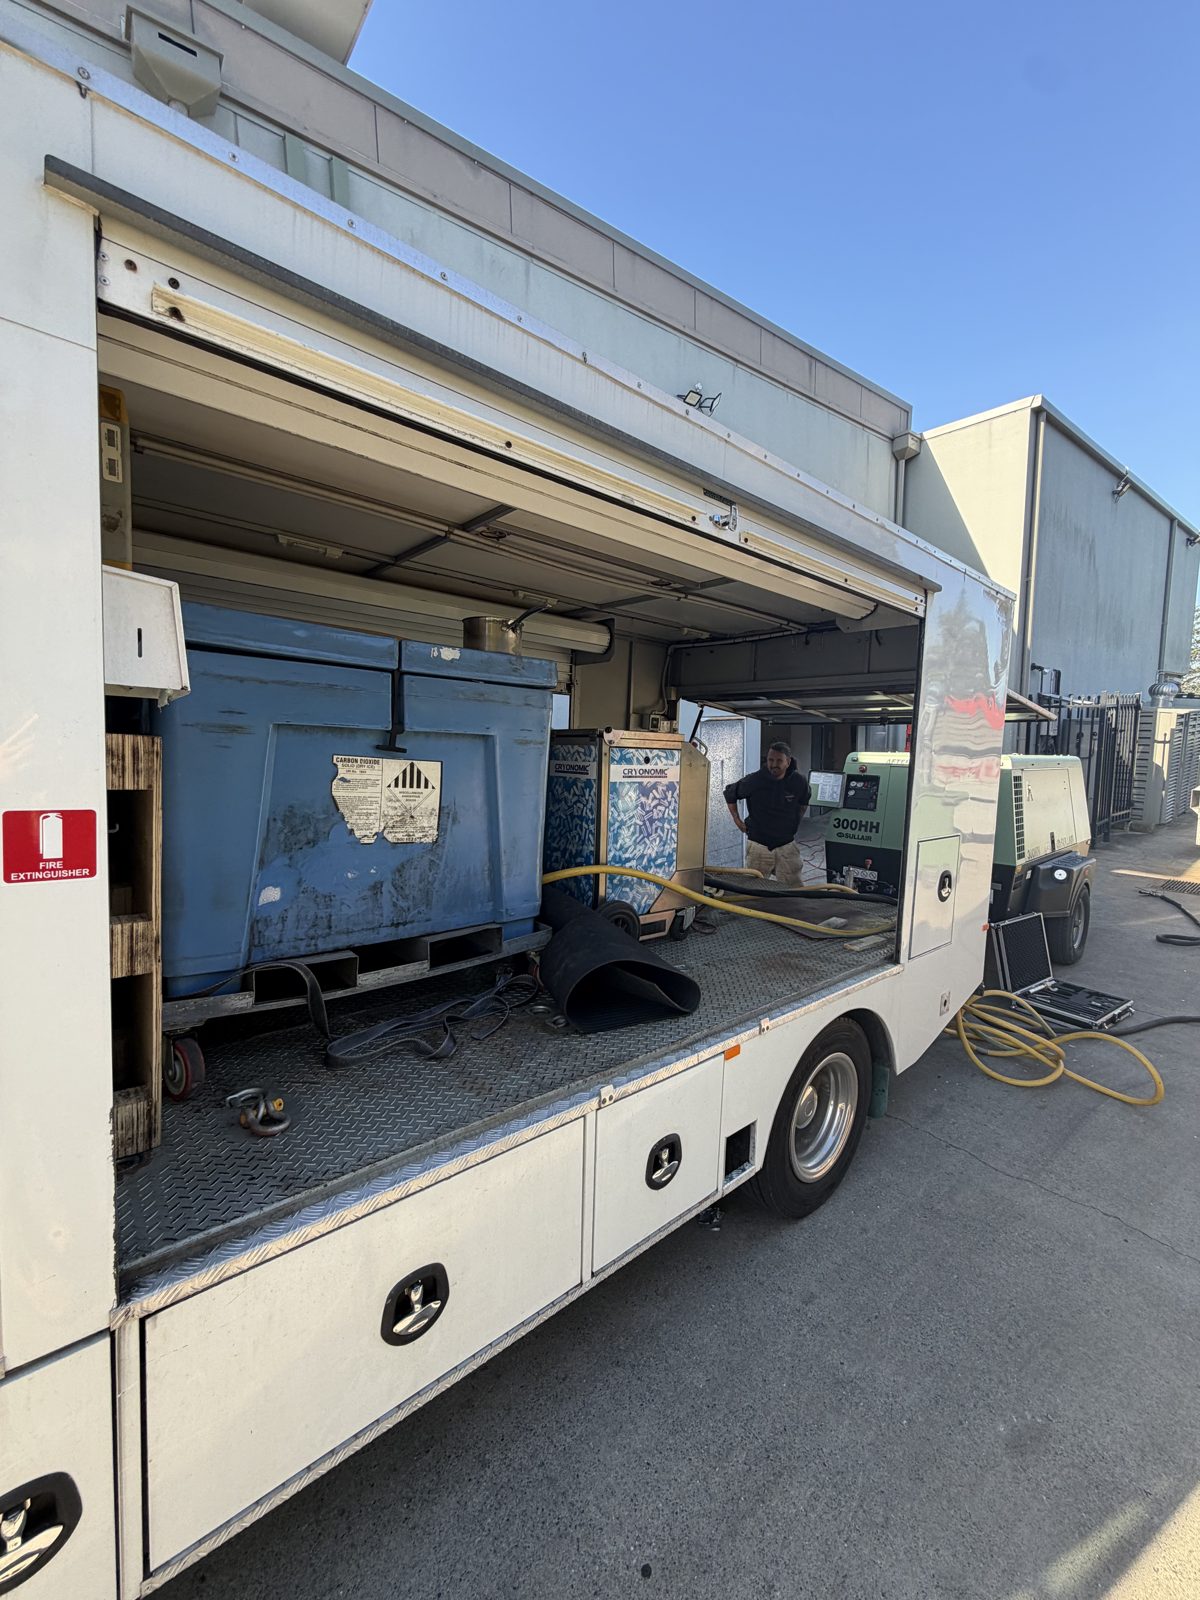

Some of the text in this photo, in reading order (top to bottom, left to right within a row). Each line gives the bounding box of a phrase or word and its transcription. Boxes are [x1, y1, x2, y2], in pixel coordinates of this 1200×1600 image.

[555, 763, 590, 771] CRYONOMIC
[622, 767, 669, 775] CRYONOMIC
[833, 818, 880, 833] 300HH
[844, 832, 872, 841] SULLAIR
[39, 861, 63, 869] FIRE
[11, 868, 89, 880] EXTINGUISHER
